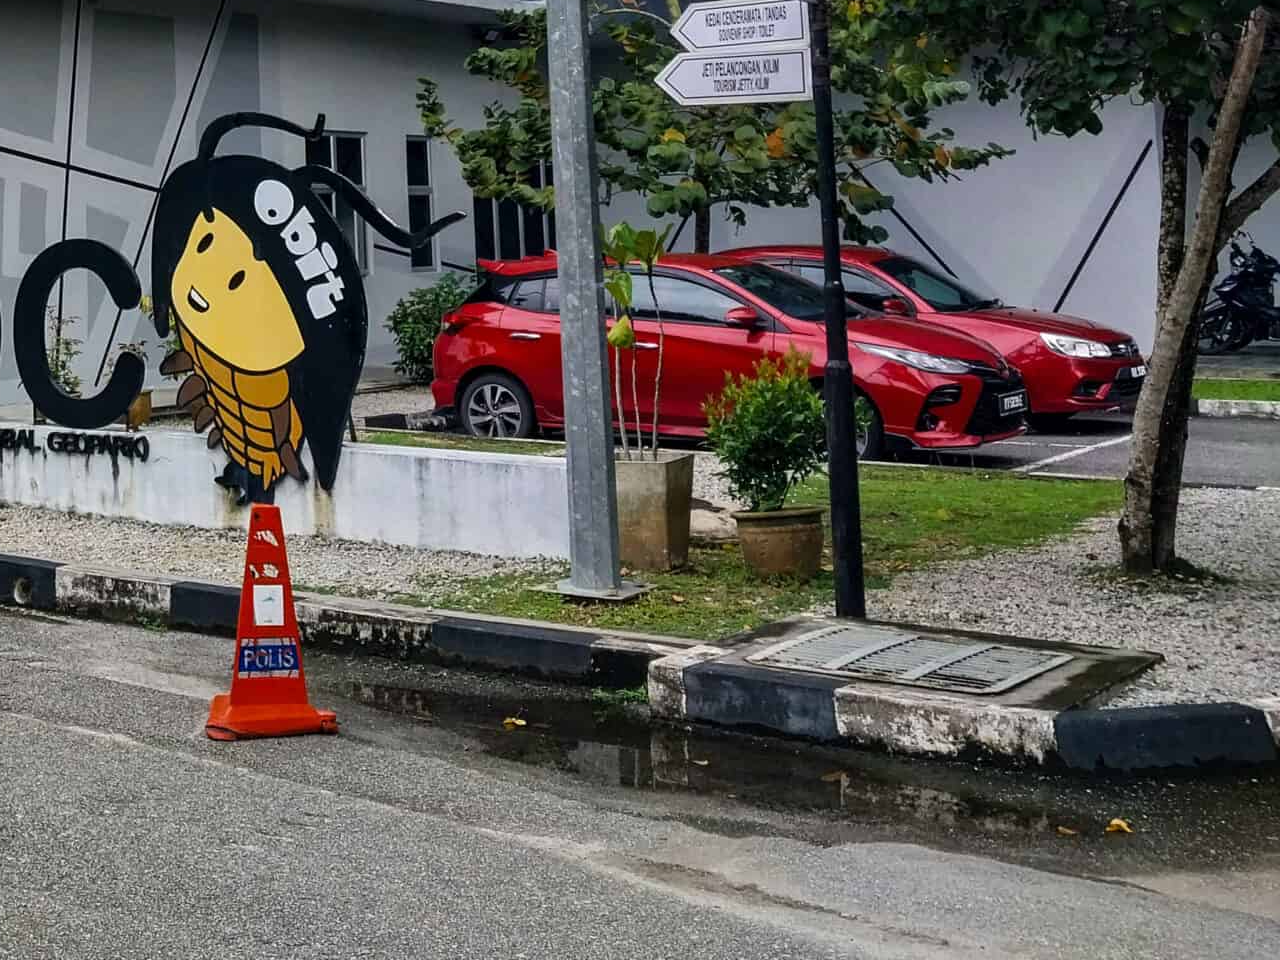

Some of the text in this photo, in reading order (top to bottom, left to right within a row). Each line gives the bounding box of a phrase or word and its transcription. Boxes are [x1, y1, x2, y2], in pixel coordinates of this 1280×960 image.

[765, 4, 787, 21] TANDAS
[713, 79, 736, 92] TOURISM
[243, 647, 295, 670] POLIS
